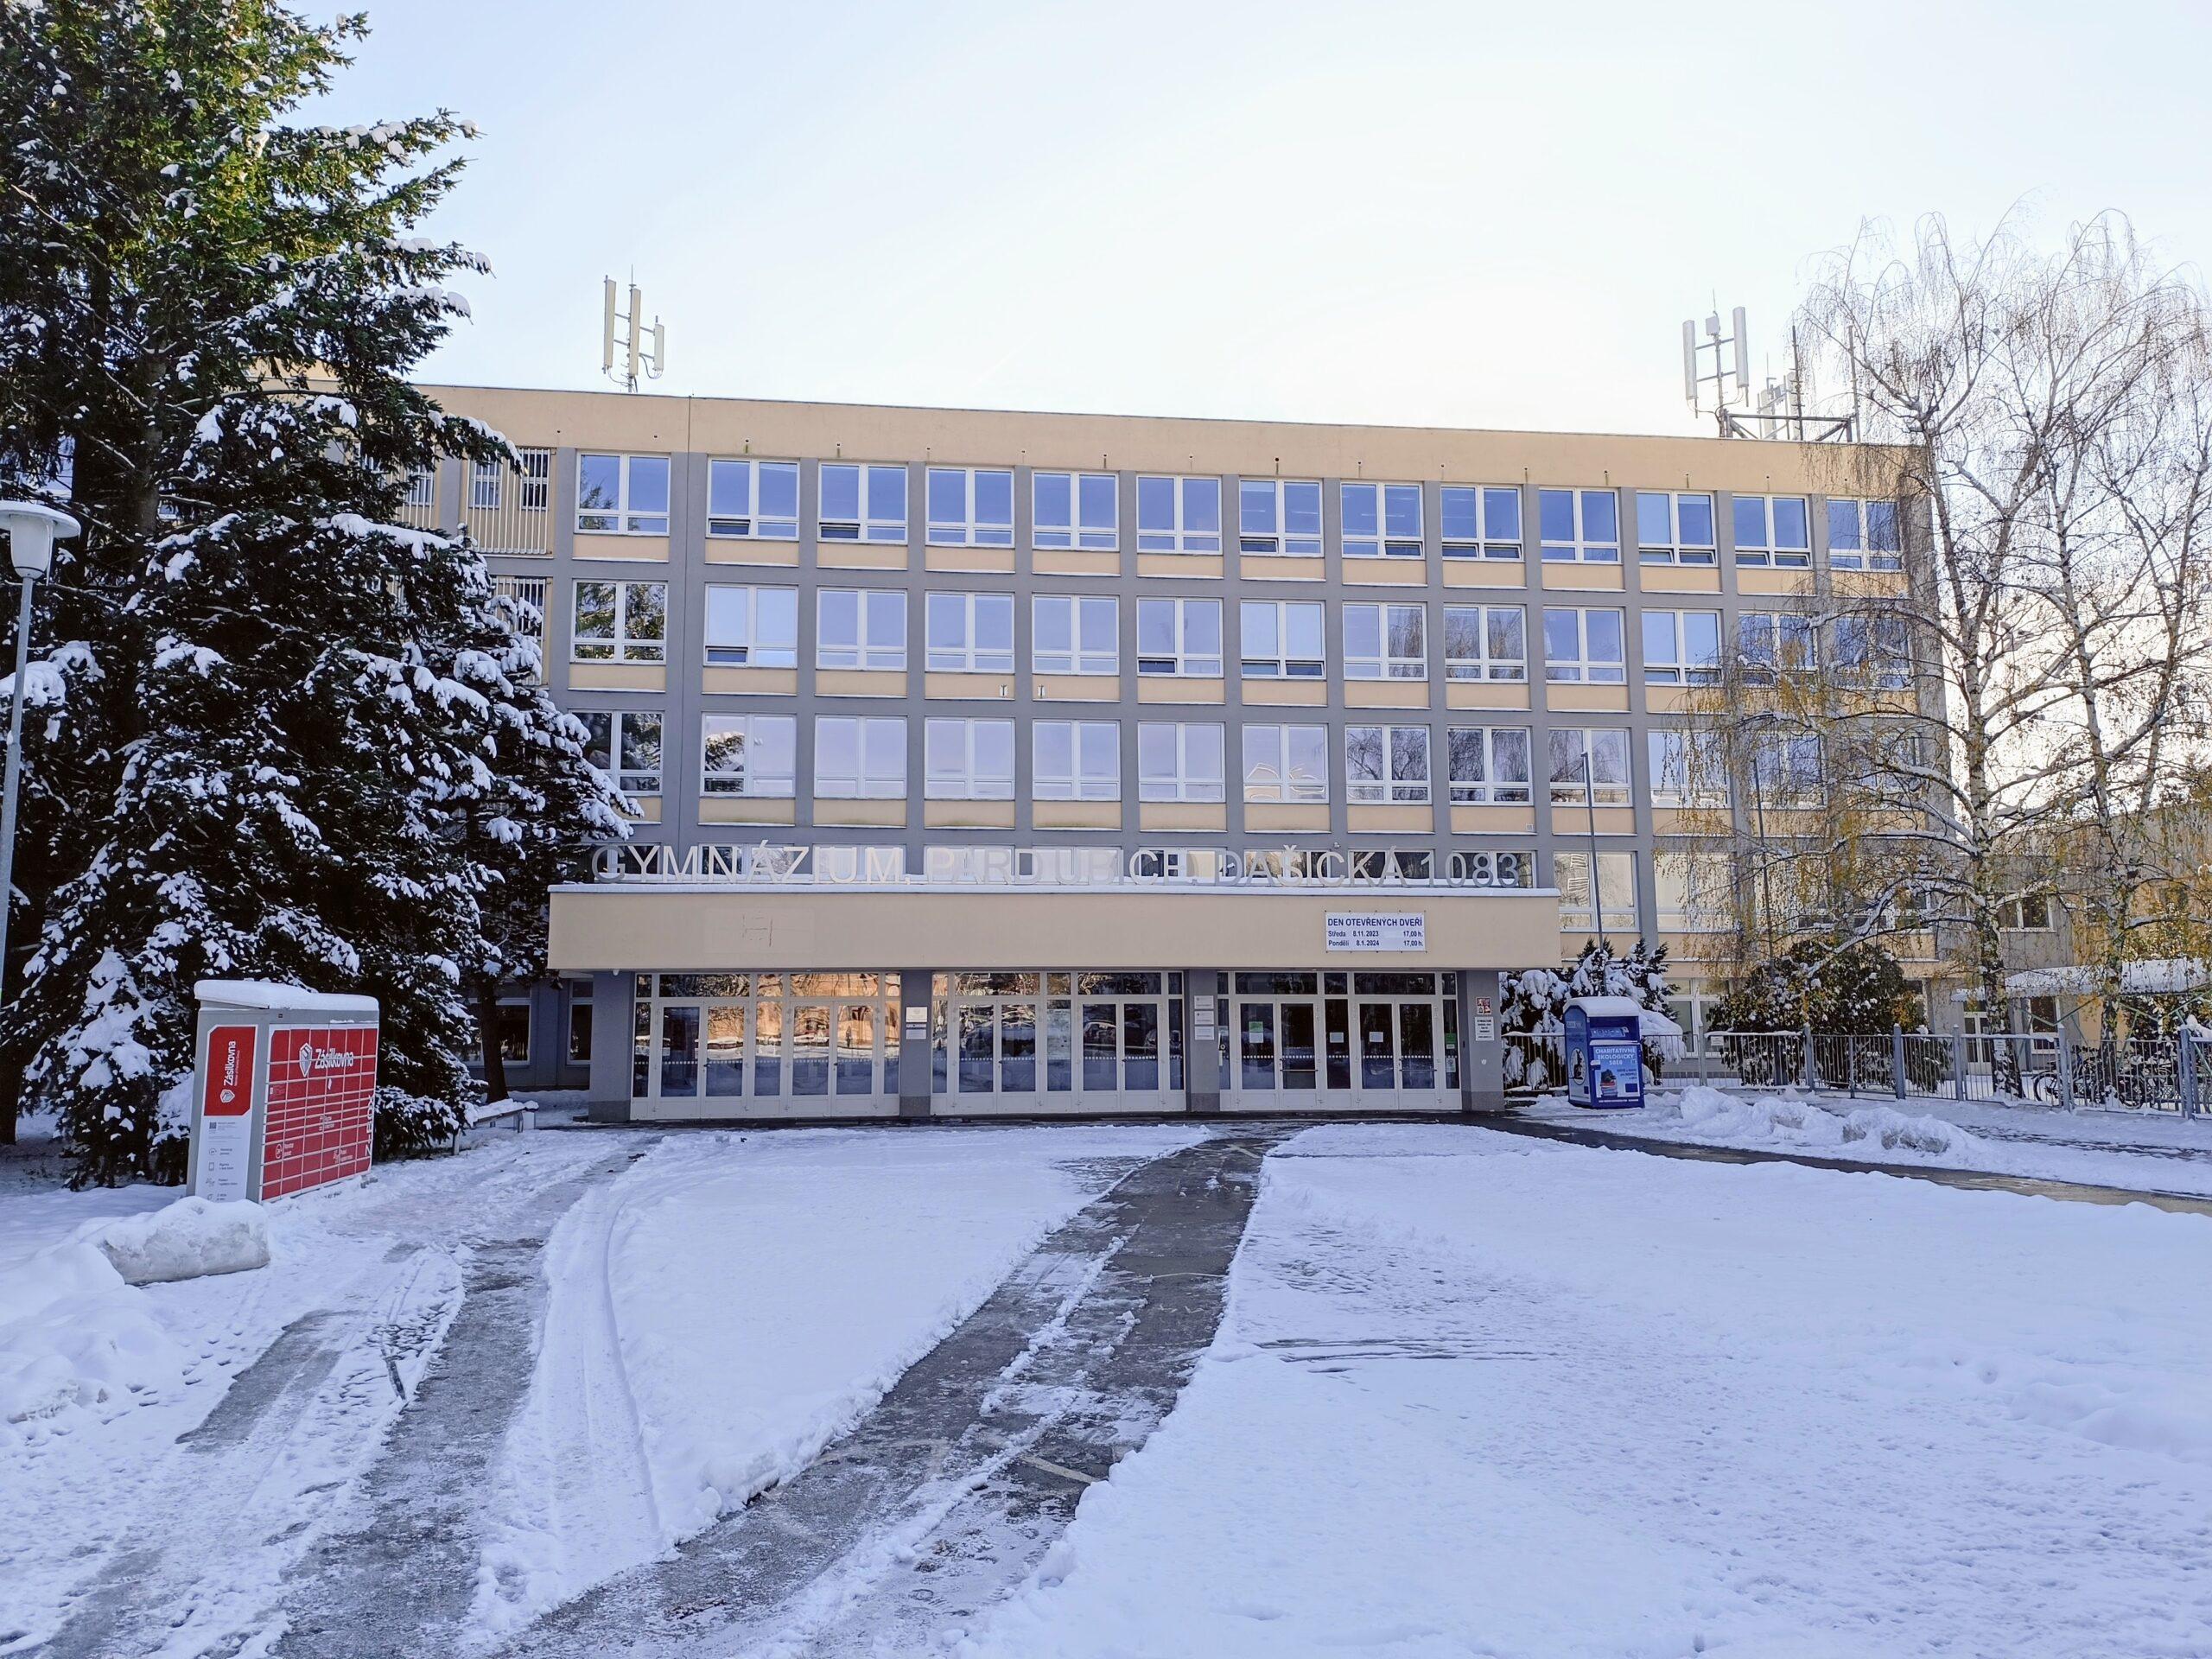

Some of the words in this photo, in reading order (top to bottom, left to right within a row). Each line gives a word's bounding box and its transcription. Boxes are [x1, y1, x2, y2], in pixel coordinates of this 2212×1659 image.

[592, 840, 910, 886] GYMNÁZIUM,
[1215, 844, 1408, 887] DAŠICKÁ
[1421, 851, 1520, 888] 1083
[1327, 918, 1344, 926] DEN
[1345, 917, 1397, 926] OTEVŘENÝCH
[1399, 917, 1422, 926] DVEŘÍ
[224, 1041, 236, 1086] Zásilkovna
[315, 1048, 354, 1069] Zásilkovna
